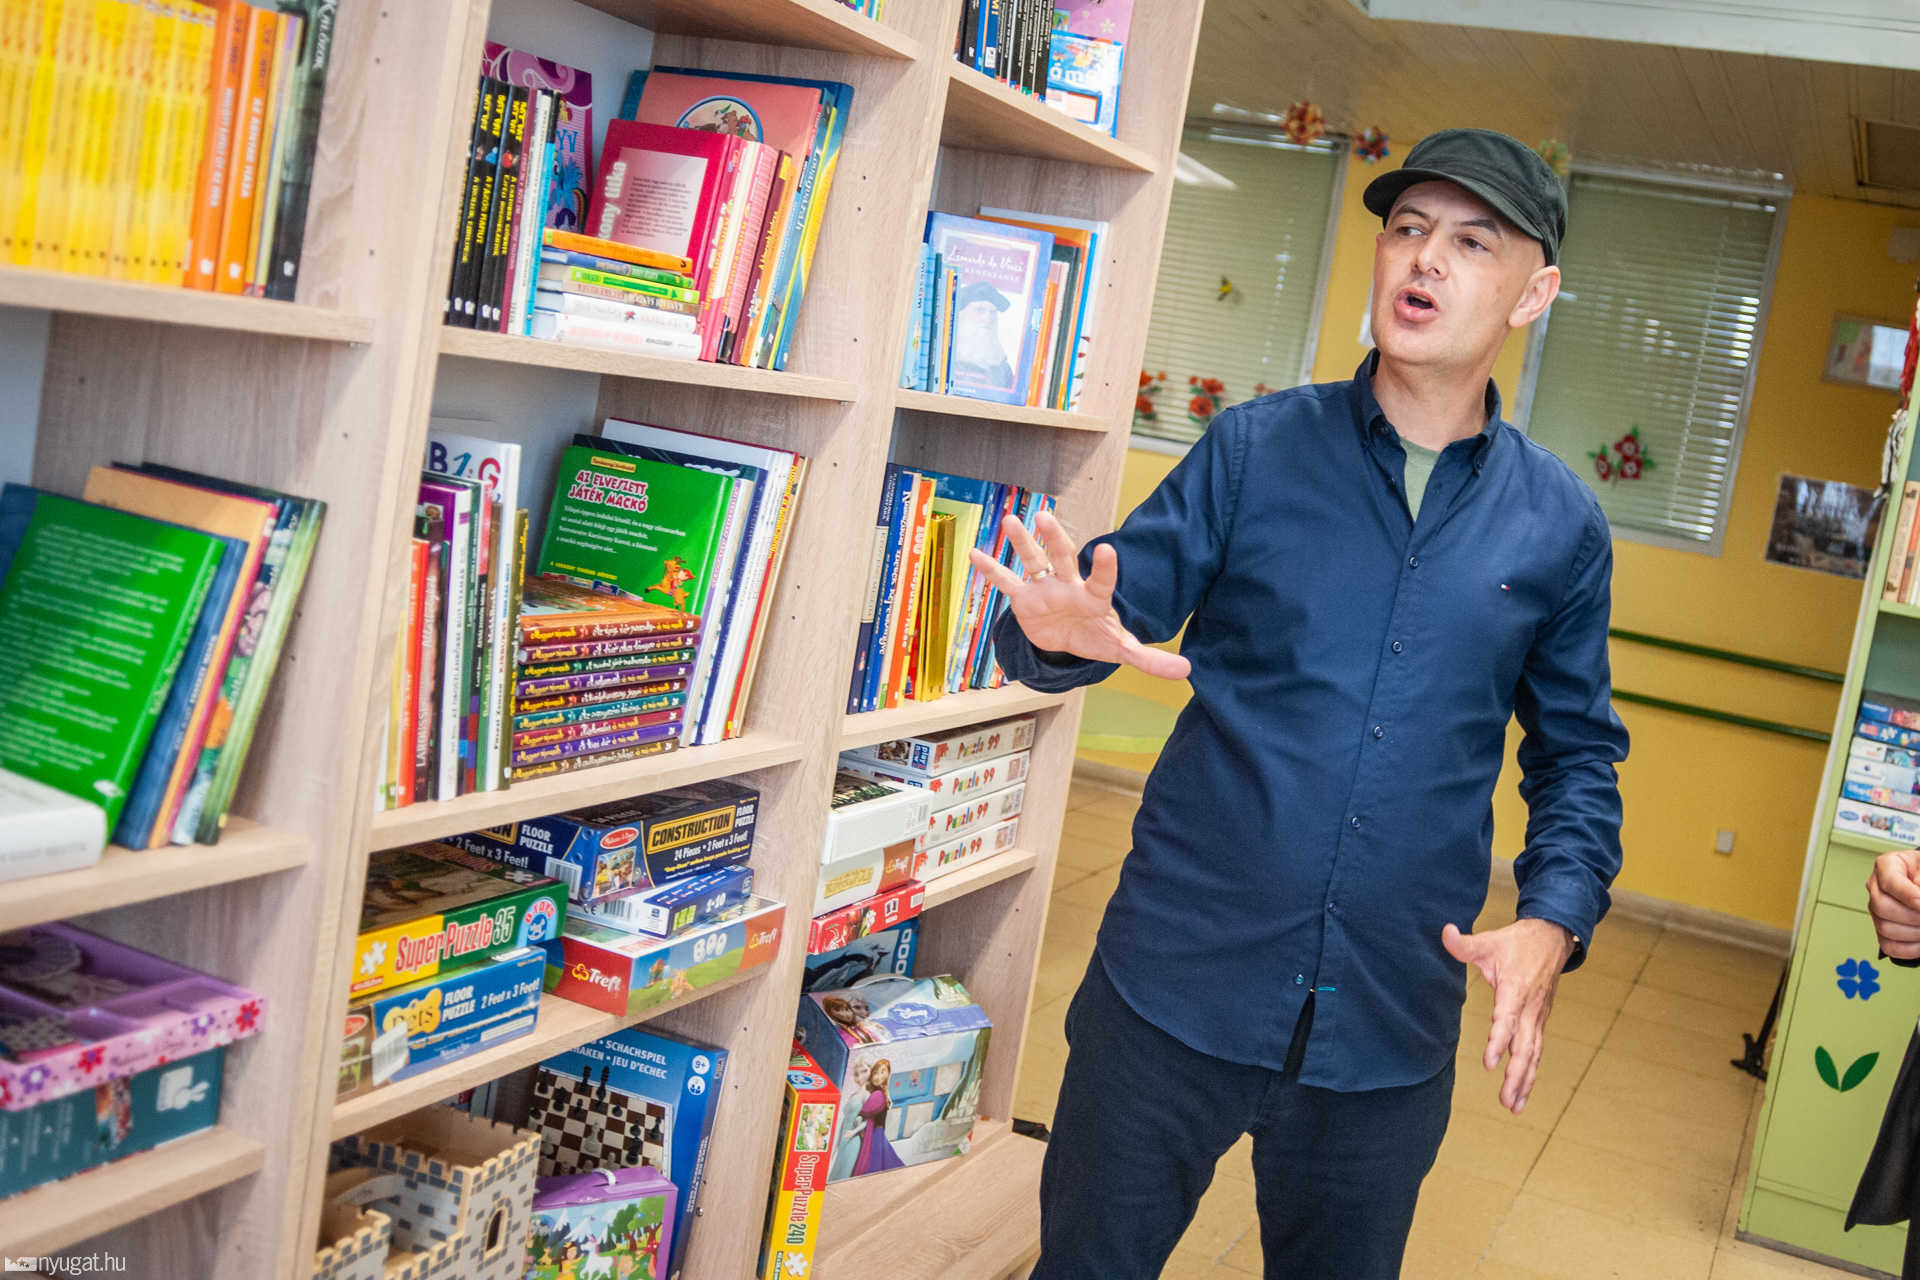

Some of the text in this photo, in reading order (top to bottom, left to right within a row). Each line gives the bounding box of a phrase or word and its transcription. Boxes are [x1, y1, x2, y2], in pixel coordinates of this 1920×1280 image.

[604, 162, 626, 198] titka
[429, 441, 448, 473] B
[576, 470, 648, 495] AZ ELVESZETT
[568, 484, 648, 512] JÁTÉK MACKÓ
[957, 733, 1001, 760] Puzzle 99
[952, 768, 996, 795] Puzzle 99
[735, 814, 755, 828] PUZZLE
[736, 804, 754, 817] FLOOR
[945, 802, 989, 832] Puzzle 99
[521, 824, 551, 842] FLOOR
[652, 812, 732, 847] CONSTRUCTION
[456, 836, 463, 848] 2
[464, 839, 485, 857] Feet
[495, 848, 501, 860] 3
[504, 850, 529, 869] Feet!
[519, 836, 554, 855] PUZZLE
[674, 850, 683, 861] 24
[683, 846, 702, 858] Pieces
[707, 842, 712, 851] 2
[712, 838, 724, 850] Feet
[729, 834, 734, 845] 3
[938, 837, 982, 867] Puzzle 99
[492, 906, 516, 946] 35
[444, 986, 474, 1006] FLOOR
[481, 978, 540, 1010] 2 Feet x 3 Feet!
[442, 1000, 476, 1022] PUZZLE
[605, 1039, 667, 1066] SCHACHSPIEL
[612, 1054, 629, 1068] JEU
[630, 1060, 667, 1079] D'ECHEC
[786, 1223, 807, 1245] 240
